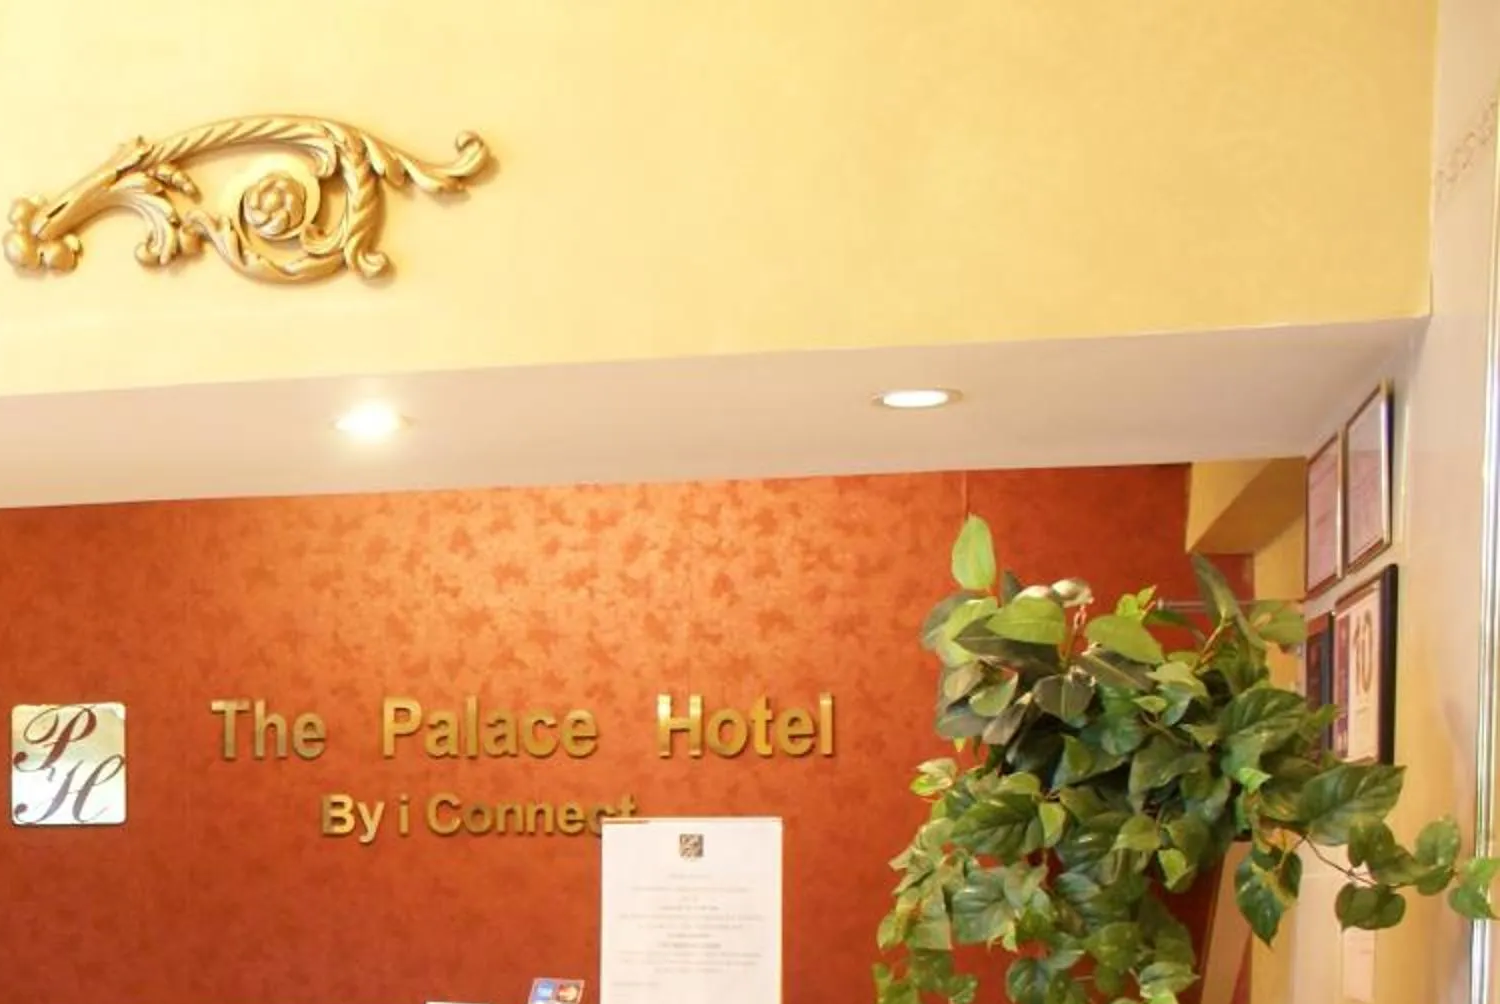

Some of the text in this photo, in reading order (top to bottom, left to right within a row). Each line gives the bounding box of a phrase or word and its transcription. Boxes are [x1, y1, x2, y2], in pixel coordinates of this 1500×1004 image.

[211, 692, 835, 760] The Palace Hotel
[321, 794, 386, 845] By
[399, 794, 410, 837] i
